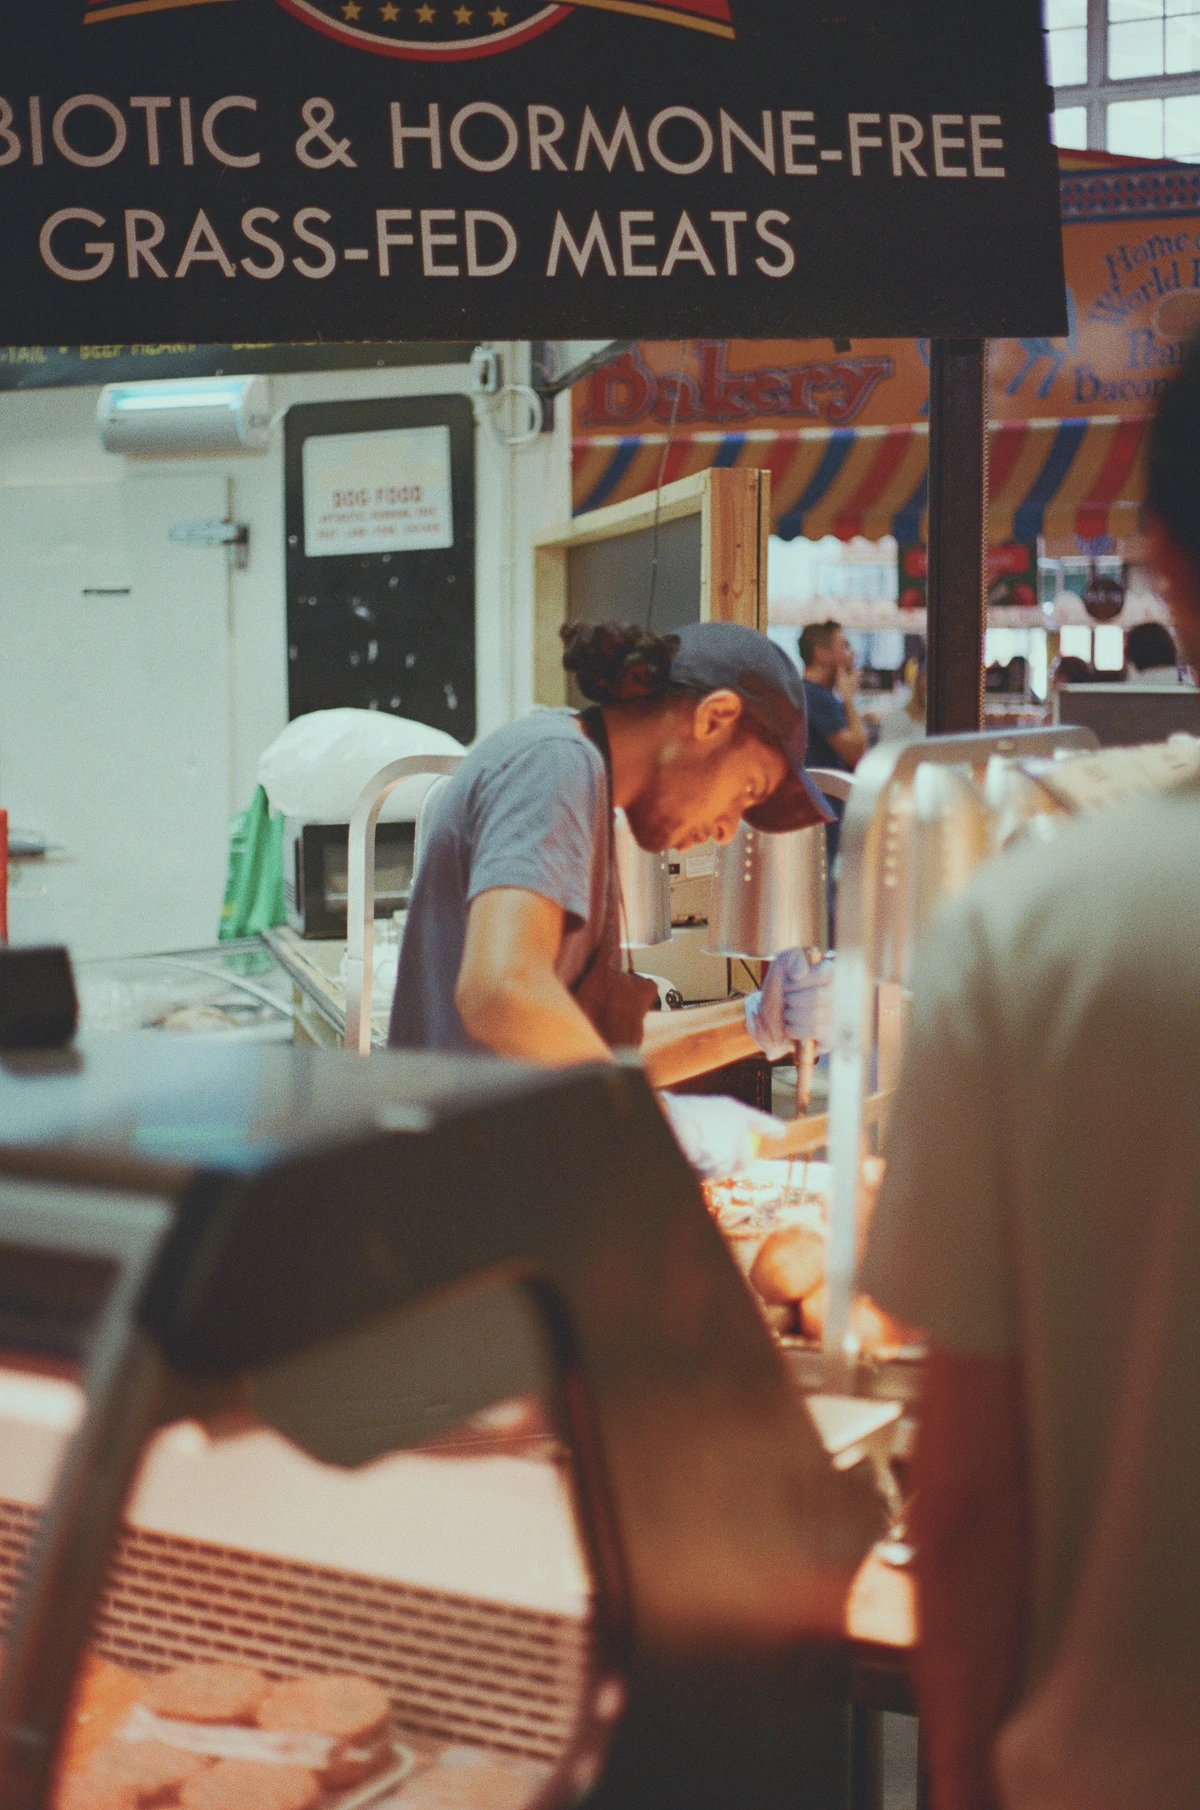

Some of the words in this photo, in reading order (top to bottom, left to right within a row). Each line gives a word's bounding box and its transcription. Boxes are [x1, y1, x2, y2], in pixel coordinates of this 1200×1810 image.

[295, 97, 357, 169] &
[390, 102, 1006, 178] HORMONE-FREE
[39, 207, 518, 281] GRASS-FED
[546, 209, 795, 278] MEATS
[1103, 232, 1190, 279] Home
[1086, 259, 1181, 324] World
[582, 339, 893, 424] Bakery
